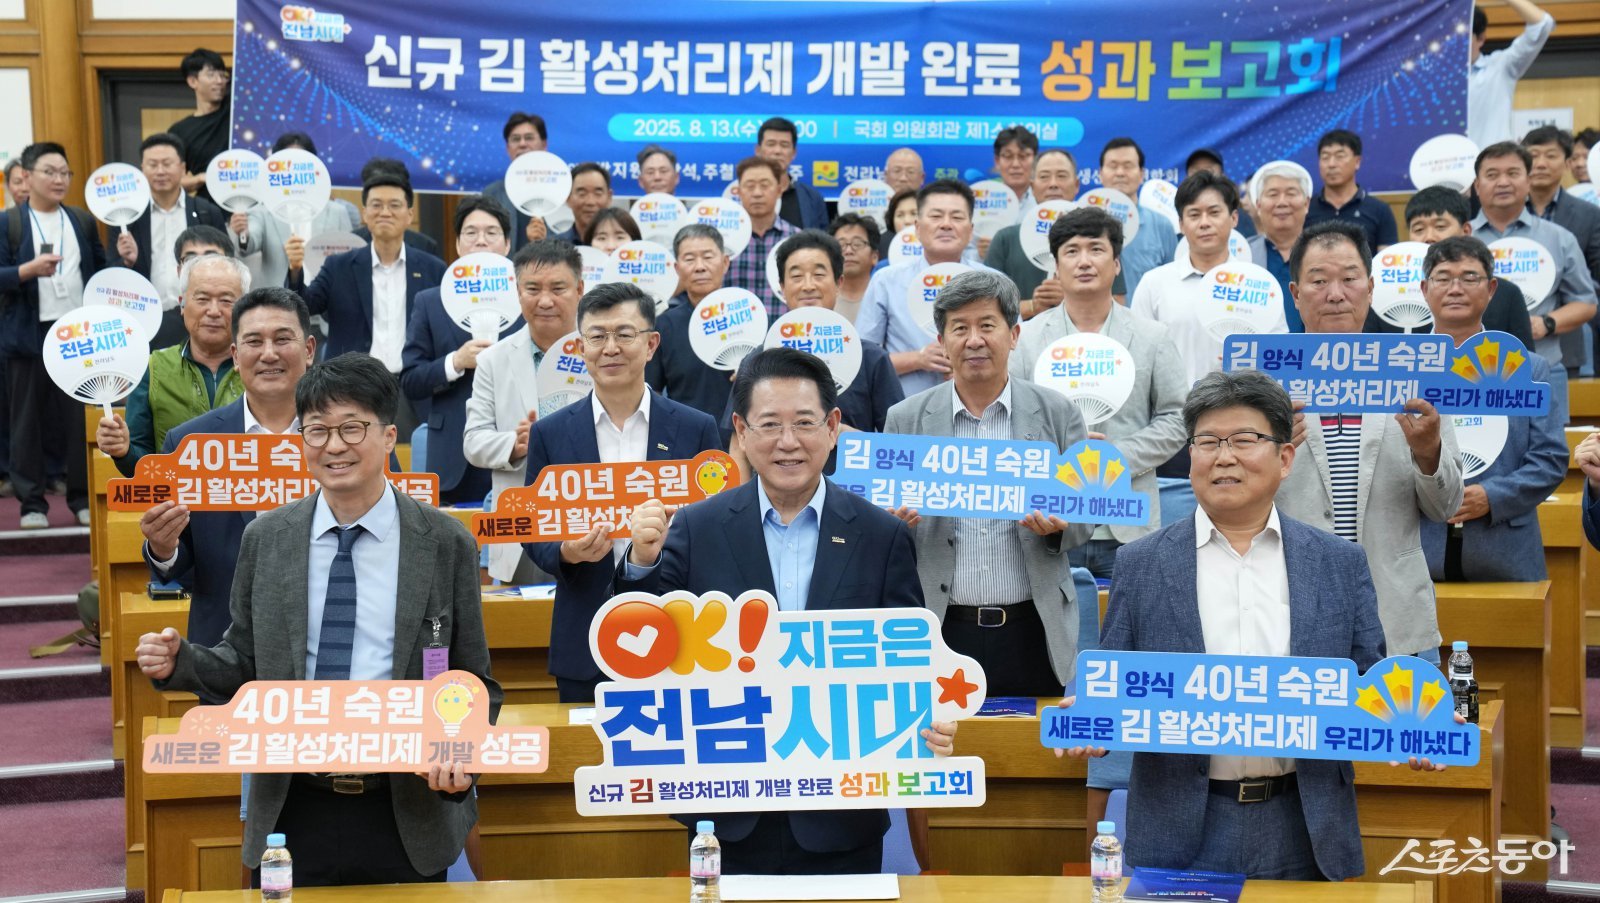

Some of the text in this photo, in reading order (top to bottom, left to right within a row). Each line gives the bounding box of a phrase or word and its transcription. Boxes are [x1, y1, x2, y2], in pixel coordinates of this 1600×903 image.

[365, 35, 1341, 101] 신규 김 활성처리제 개발 완료 성과 보고회
[634, 119, 684, 137] 2025.
[689, 119, 705, 137] 8.
[855, 120, 887, 138] 국회
[892, 120, 960, 139] 의원회관
[965, 121, 1058, 141] 제1소의실
[95, 181, 137, 198] 전남시대
[268, 173, 316, 187] 전남시대
[453, 265, 481, 278] OK!
[618, 262, 666, 275] 전남시대
[1382, 253, 1412, 267] OK!
[454, 278, 509, 294] 전남시대
[1215, 271, 1244, 285] OK!
[700, 298, 749, 320] OK! 지금은
[1212, 284, 1268, 307] 전남시대
[56, 319, 123, 342] OK! 지금은
[702, 309, 753, 335] 전남시대
[780, 322, 842, 338] OK! 지금은
[59, 331, 128, 360] 전남시대
[1051, 346, 1114, 360] OK! 지금은
[1231, 341, 1446, 372] 김 양식 40년 숙원
[1051, 360, 1115, 377] 전남시대
[1289, 379, 1543, 409] 활성처리제 우리가 해냈다
[1454, 416, 1482, 427] 보고회
[179, 439, 259, 472] 40년
[844, 439, 1051, 479] 김 양식 40년 숙원
[113, 484, 171, 504] 새로운
[177, 477, 202, 505] 김
[537, 464, 690, 502] 40년 숙원
[871, 478, 896, 507] 김
[900, 479, 1026, 514] 활성처리제
[1030, 494, 1085, 515] 우리가
[1089, 496, 1144, 519] 해냈다
[477, 516, 532, 538] 새로운
[537, 507, 562, 536] 김
[597, 598, 932, 680] OK! 지금은
[1085, 660, 1349, 707] 김 양식 40년 숙원
[233, 686, 424, 725] 40년 숙원
[600, 680, 935, 767] 전남시대
[1048, 709, 1471, 756] 새로운 김 활성처리제 우리가 해냈다
[150, 732, 541, 766] 새로운 김 활성처리제 개발 성공
[588, 770, 973, 804] 신규 김 활성처리제 개발 완료 성과 보고회
